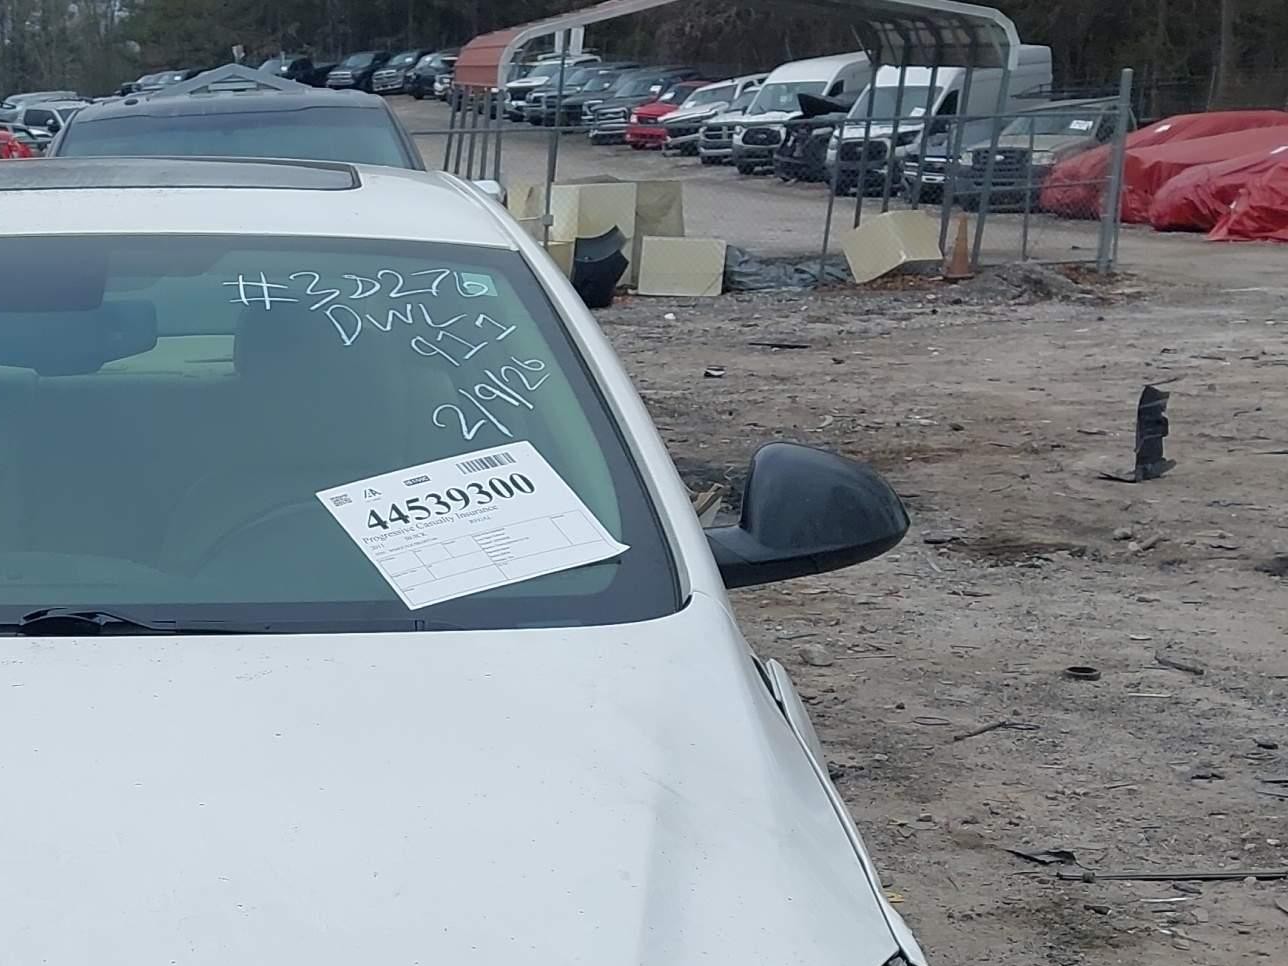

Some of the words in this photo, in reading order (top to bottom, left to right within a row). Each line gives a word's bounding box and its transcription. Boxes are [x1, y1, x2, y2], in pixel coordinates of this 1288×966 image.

[432, 356, 551, 440] 2/9/26
[363, 526, 415, 545] Progressive
[455, 504, 498, 520] Insurance
[367, 472, 535, 530] 44539300
